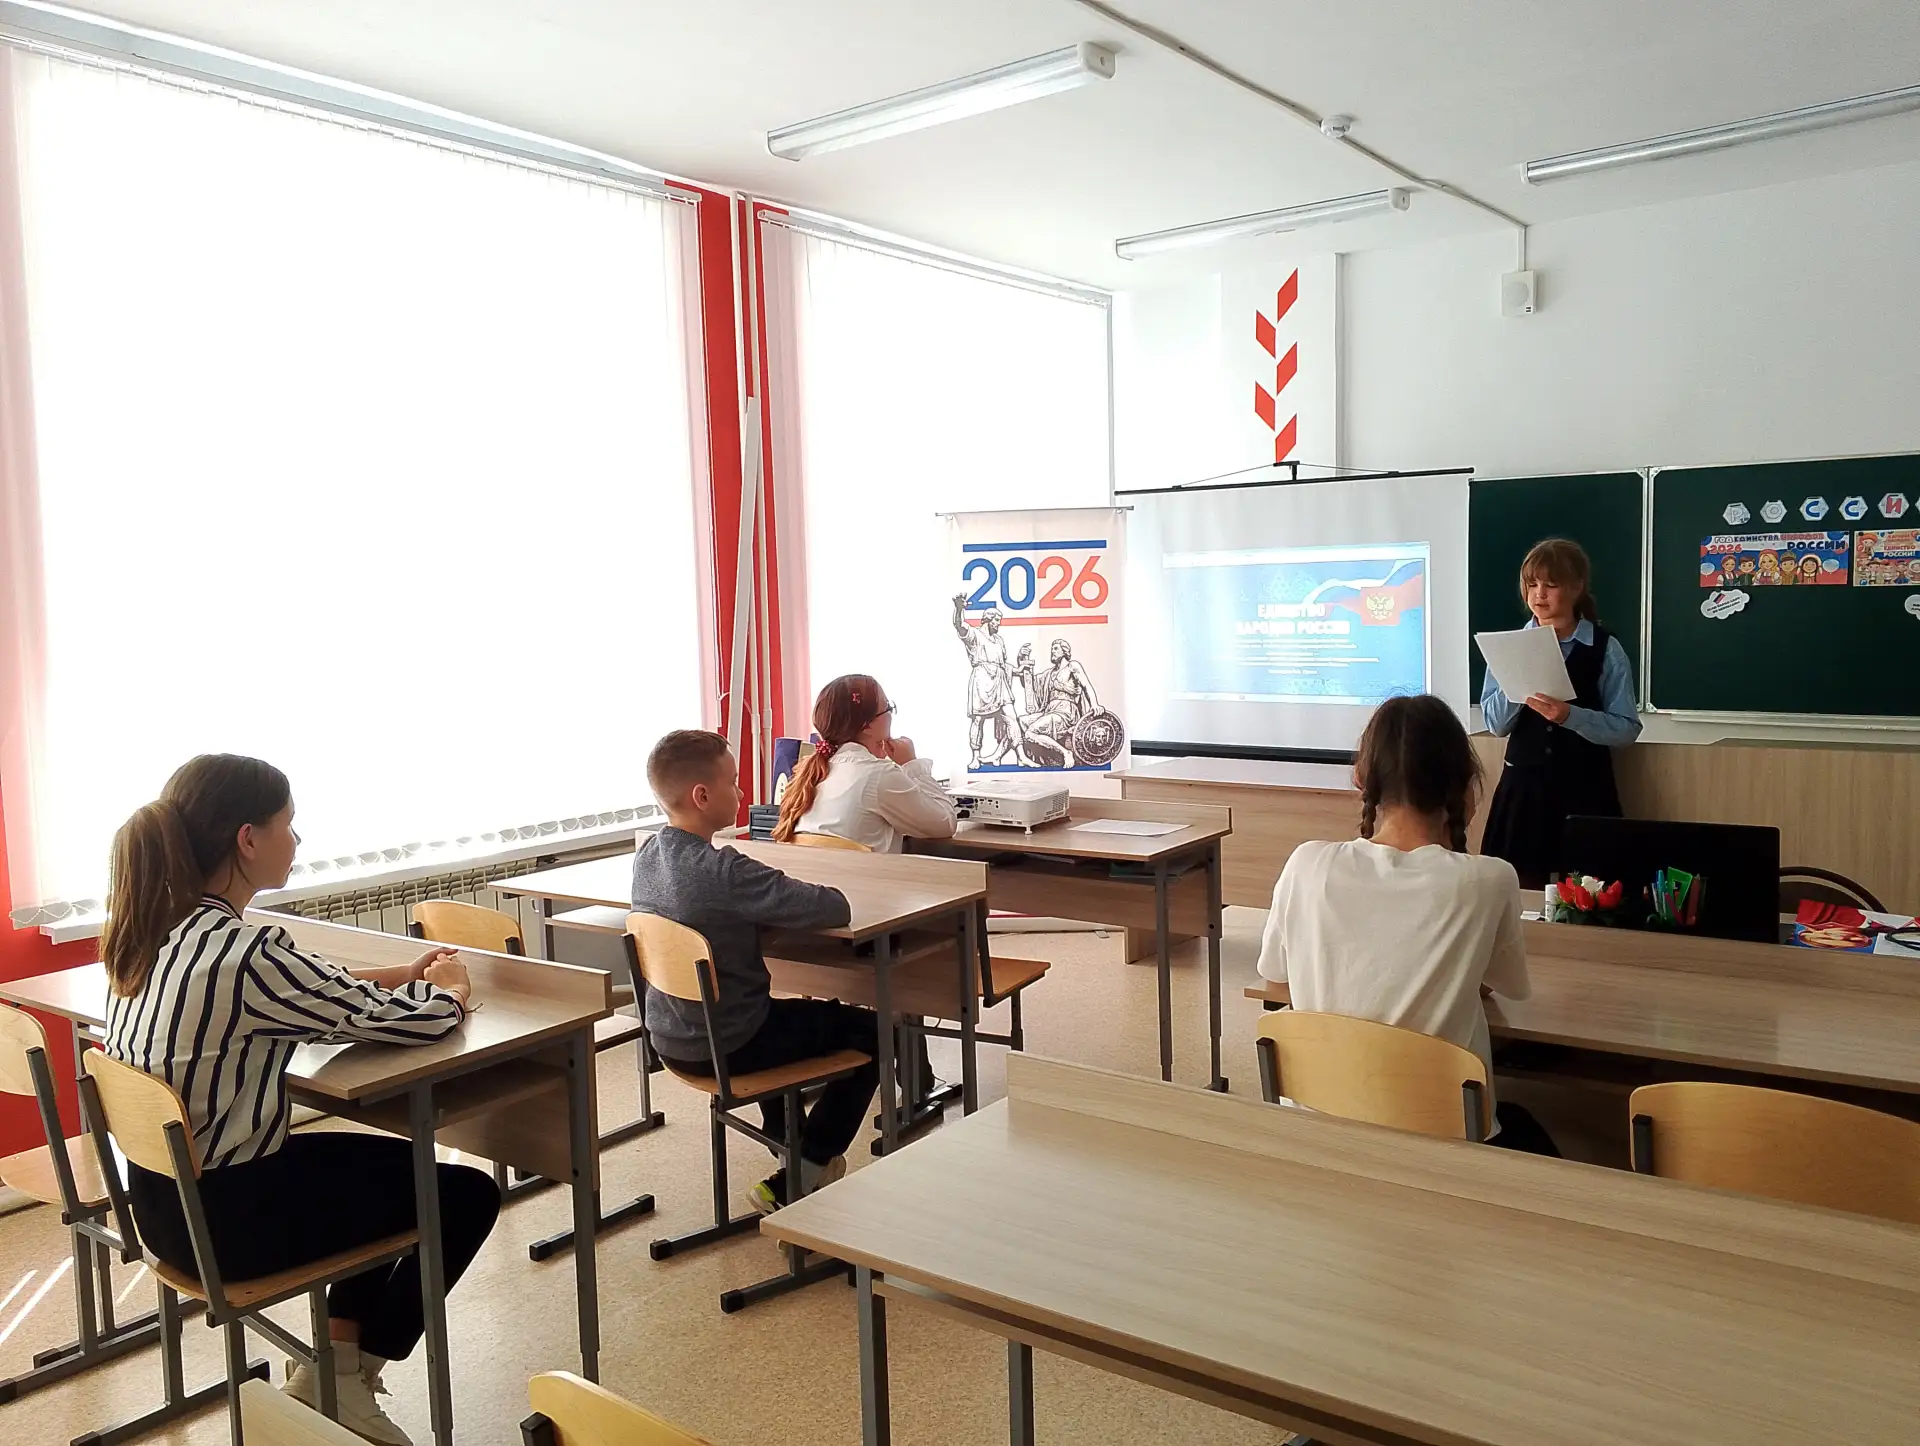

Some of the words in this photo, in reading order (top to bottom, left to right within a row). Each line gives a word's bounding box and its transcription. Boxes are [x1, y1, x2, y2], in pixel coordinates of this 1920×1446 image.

[1734, 534, 1779, 543] ЕДИНСТВА
[1709, 544, 1743, 554] 2026
[1787, 540, 1846, 551] РОССИИ
[962, 555, 1109, 611] 2026
